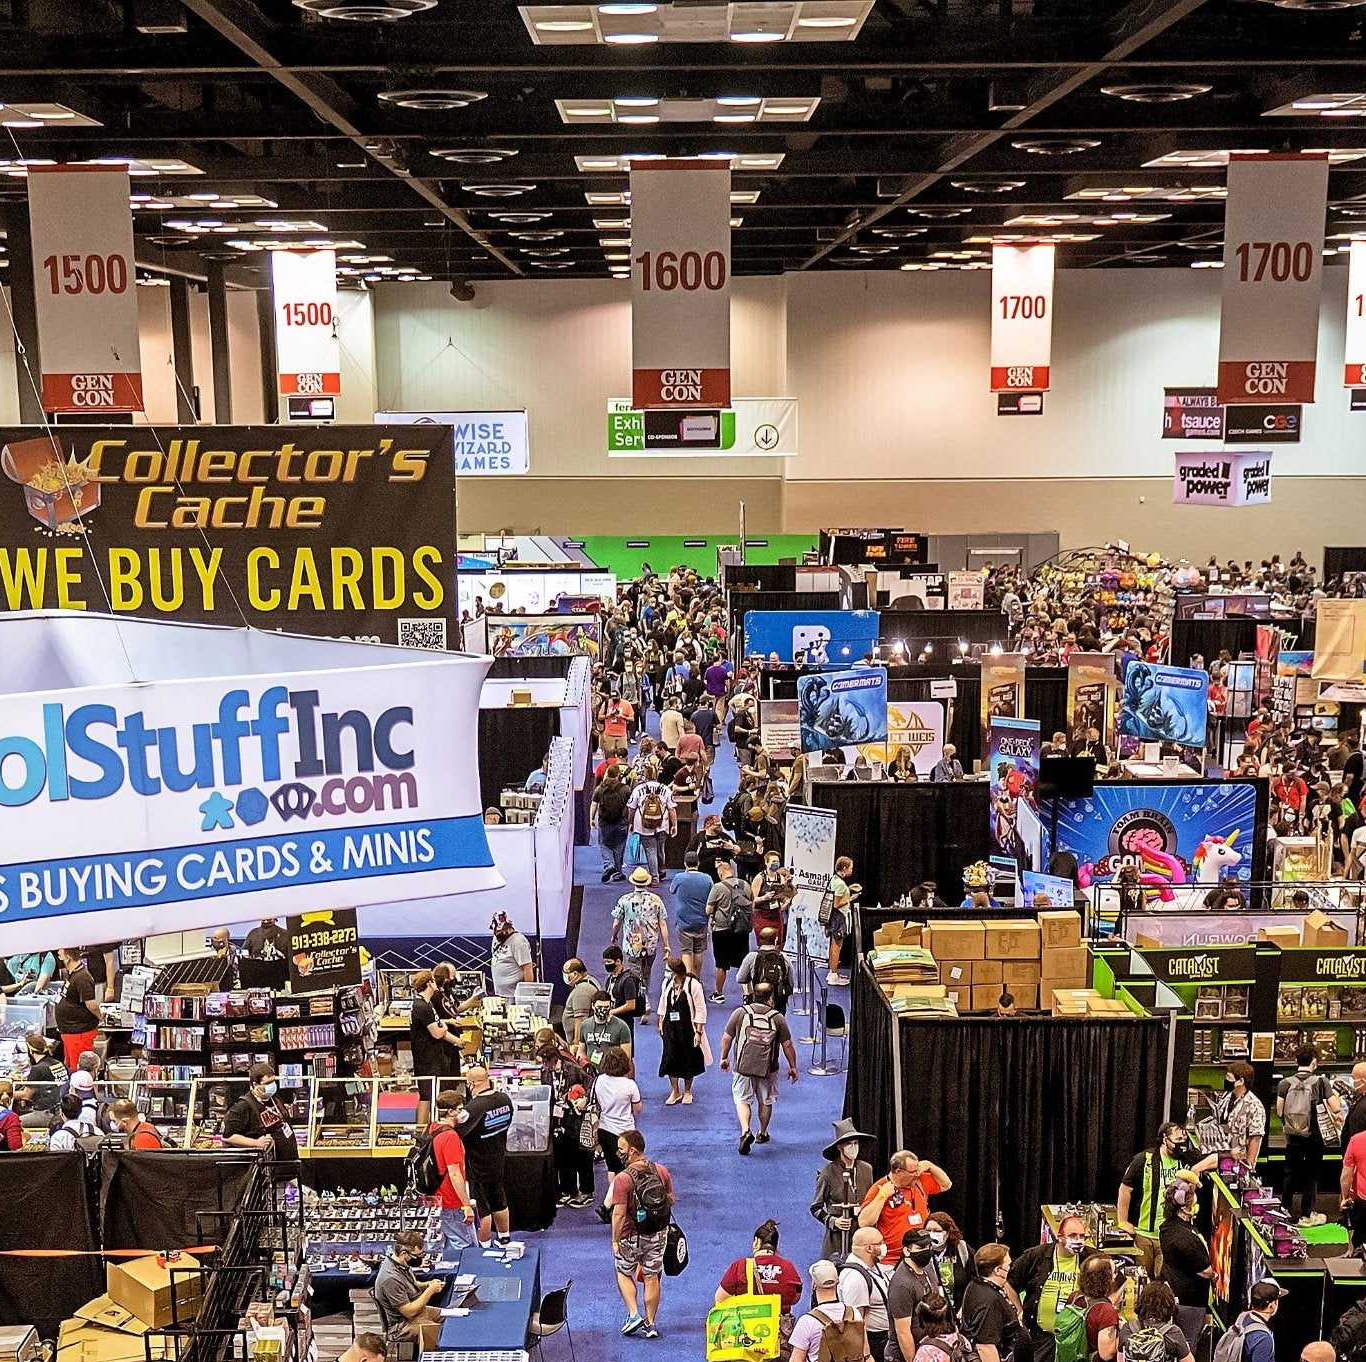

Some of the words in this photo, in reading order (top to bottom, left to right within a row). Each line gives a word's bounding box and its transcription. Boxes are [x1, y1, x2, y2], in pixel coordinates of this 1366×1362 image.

[636, 251, 726, 291] 1600
[1236, 242, 1313, 281] 1700
[43, 255, 127, 295] 1500
[282, 303, 332, 326] 1500
[999, 296, 1046, 319] 1700
[660, 370, 702, 385] GEN
[1246, 363, 1288, 378] GEN
[71, 375, 113, 391] GEN
[660, 386, 702, 401] CON
[1245, 378, 1288, 394] CON
[72, 391, 114, 407] CON
[88, 439, 430, 483] Collector's
[1179, 463, 1220, 479] graded
[1186, 479, 1230, 499] power
[134, 486, 326, 530] Cache
[108, 546, 224, 612] BUY
[247, 545, 445, 612] CARDS
[998, 745, 1033, 758] GALAXY
[19, 857, 167, 910] BUYING
[175, 841, 300, 890] CARDS
[309, 838, 334, 875] &
[341, 827, 436, 871] MINIS
[1168, 957, 1220, 979] CATALYST
